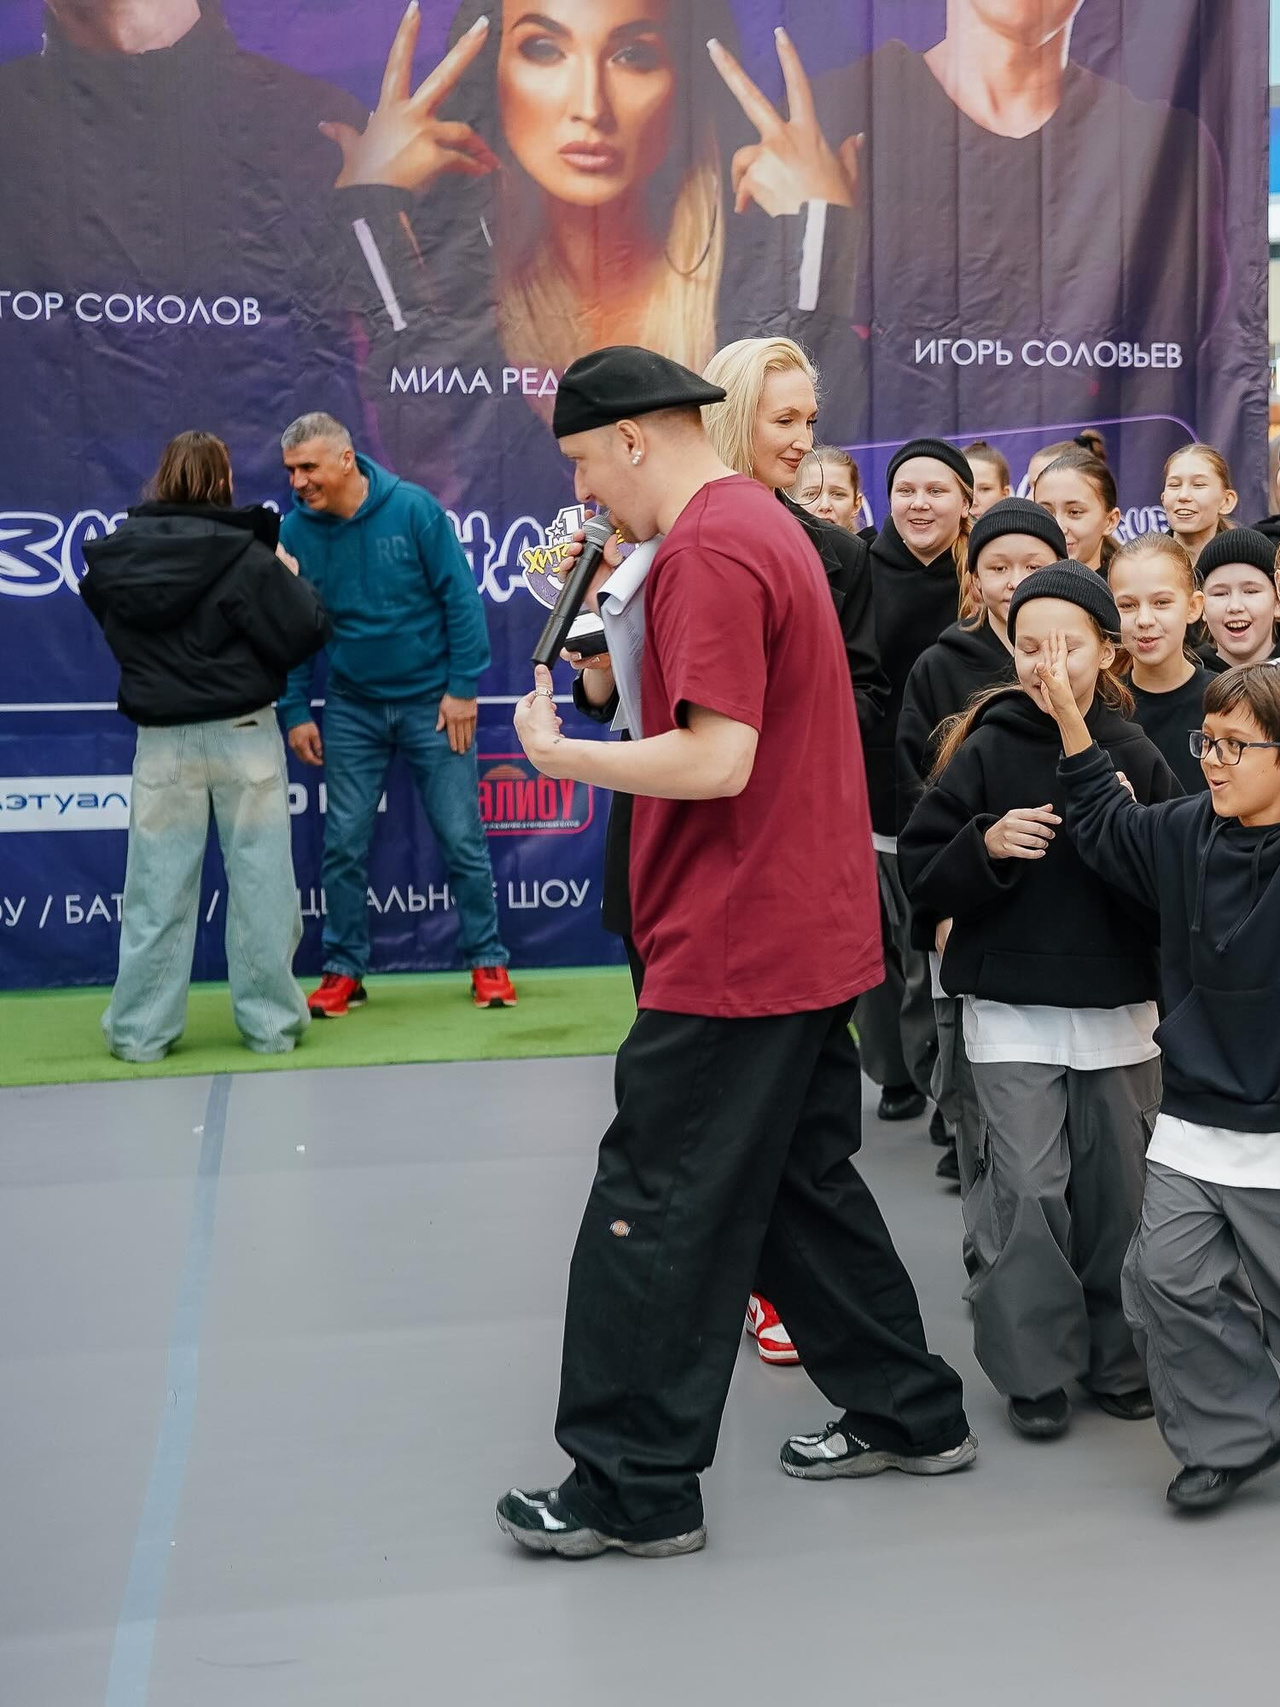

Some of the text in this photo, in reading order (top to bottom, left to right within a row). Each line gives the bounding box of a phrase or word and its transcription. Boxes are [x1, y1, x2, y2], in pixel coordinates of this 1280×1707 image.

[75, 292, 262, 326] СОКОЛОВ
[914, 338, 1183, 369] ИГОРЬ СОЛОВЬЕВ
[390, 365, 493, 395] МИЛА
[507, 878, 591, 909] ШОУ
